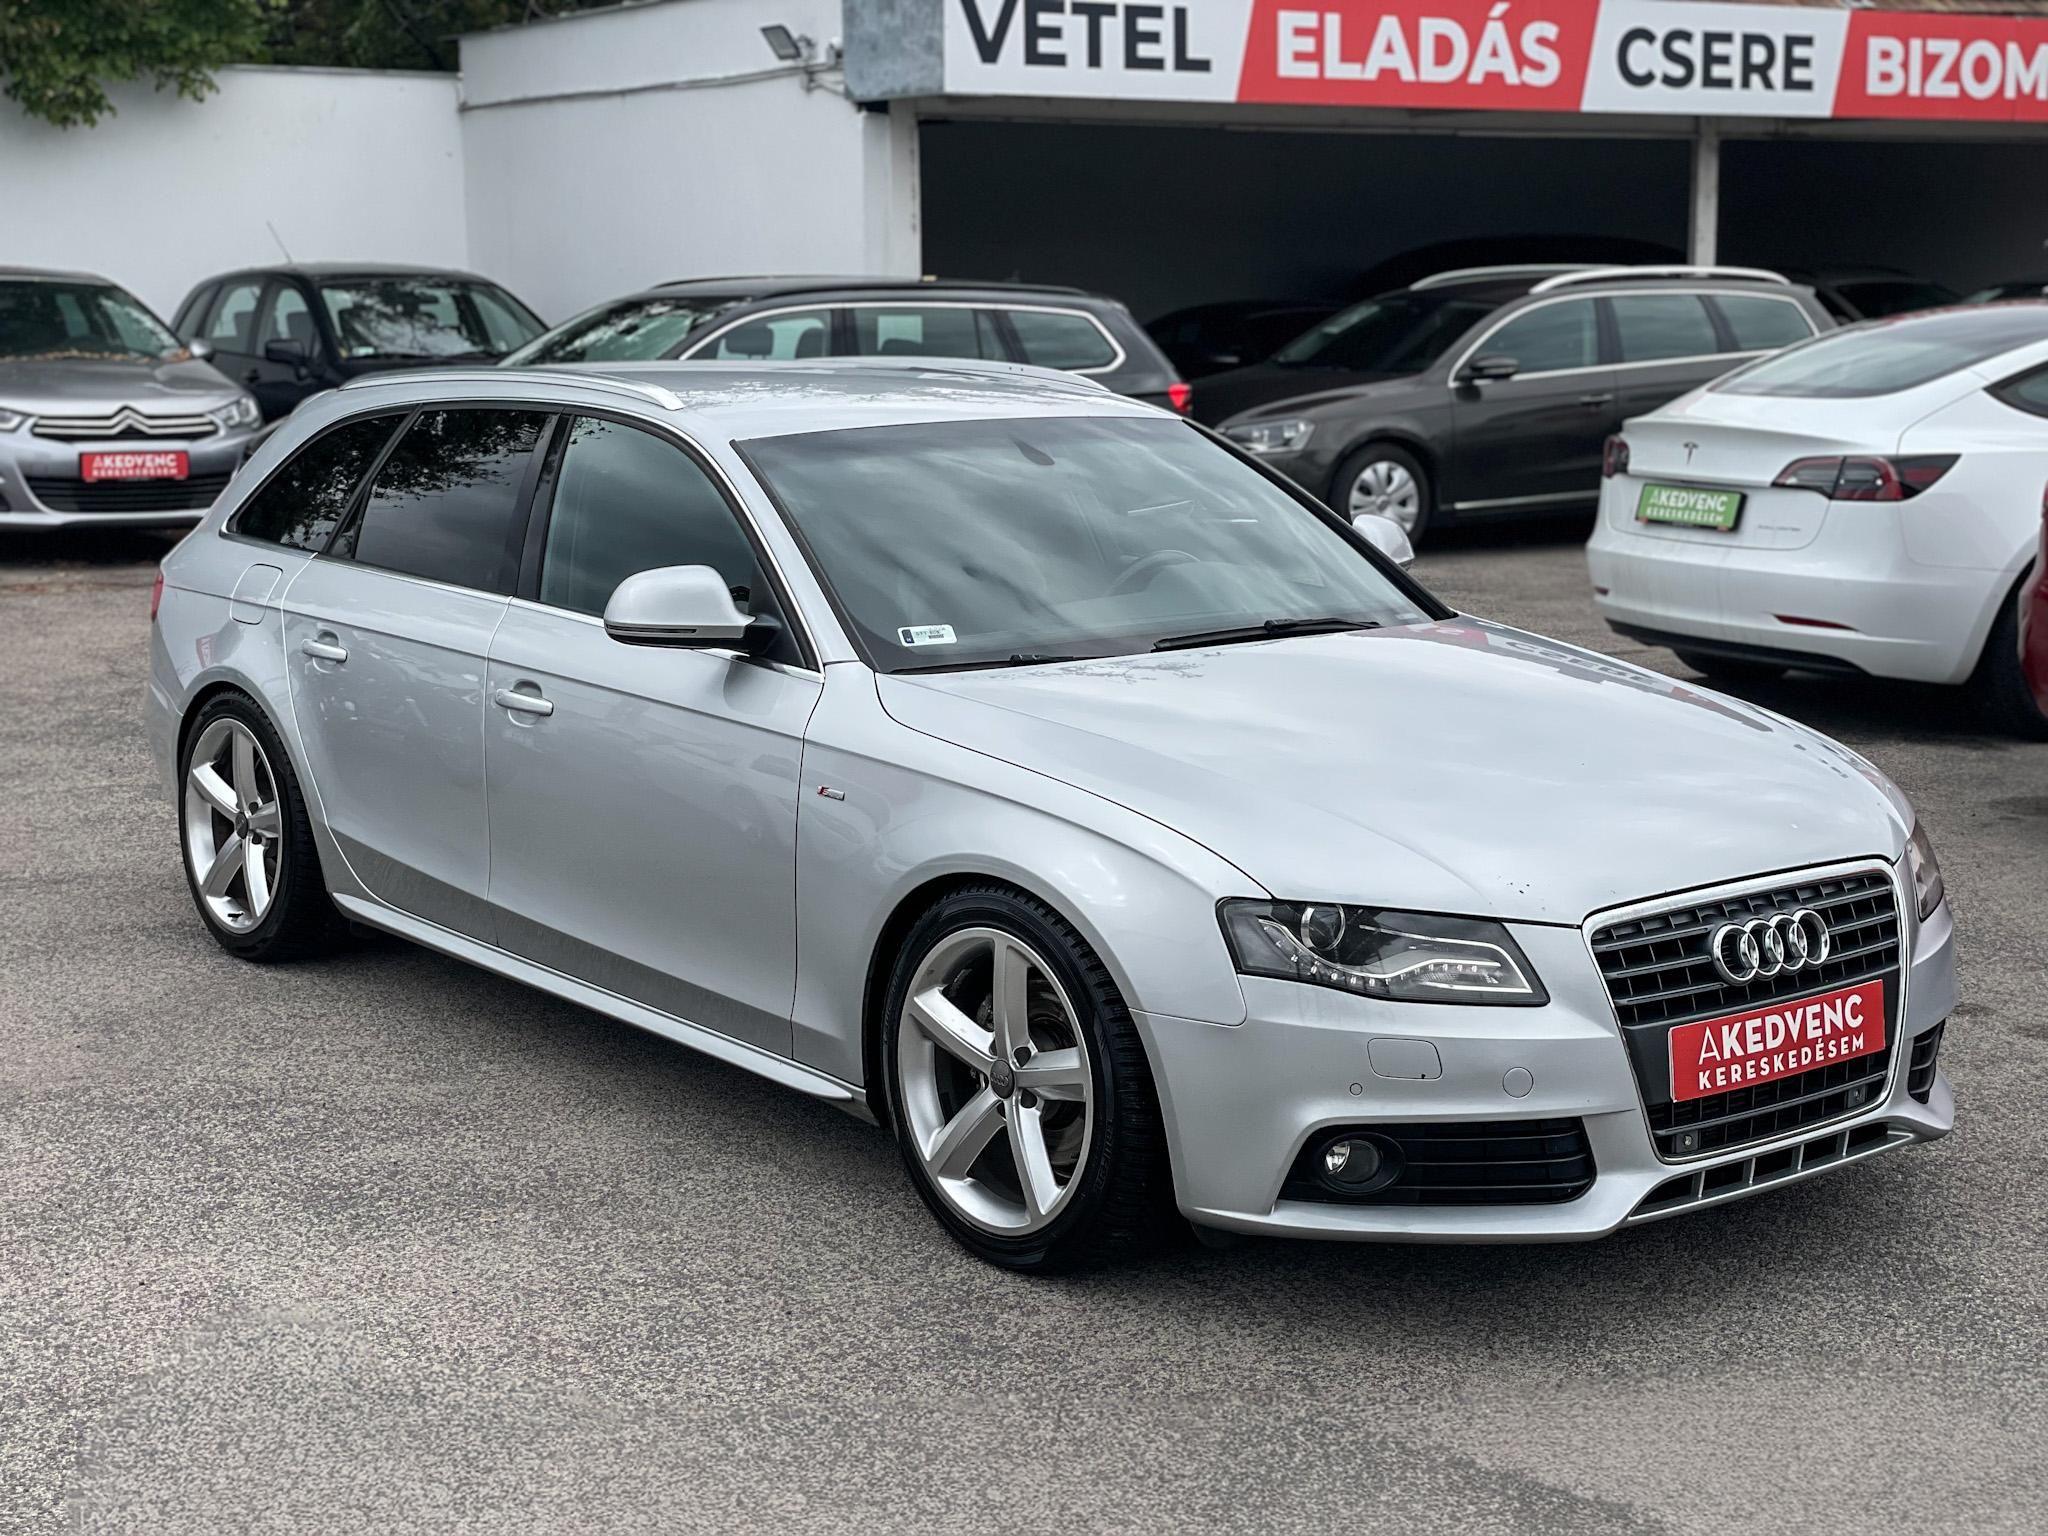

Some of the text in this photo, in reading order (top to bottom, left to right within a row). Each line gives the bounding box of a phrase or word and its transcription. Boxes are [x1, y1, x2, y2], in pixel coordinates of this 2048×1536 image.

[1276, 3, 1561, 87] ELADÁS
[1617, 27, 1814, 91] CSERE
[1866, 36, 2048, 101] BIZOM
[1699, 1032, 1865, 1090] KERESKEDÉSEM
